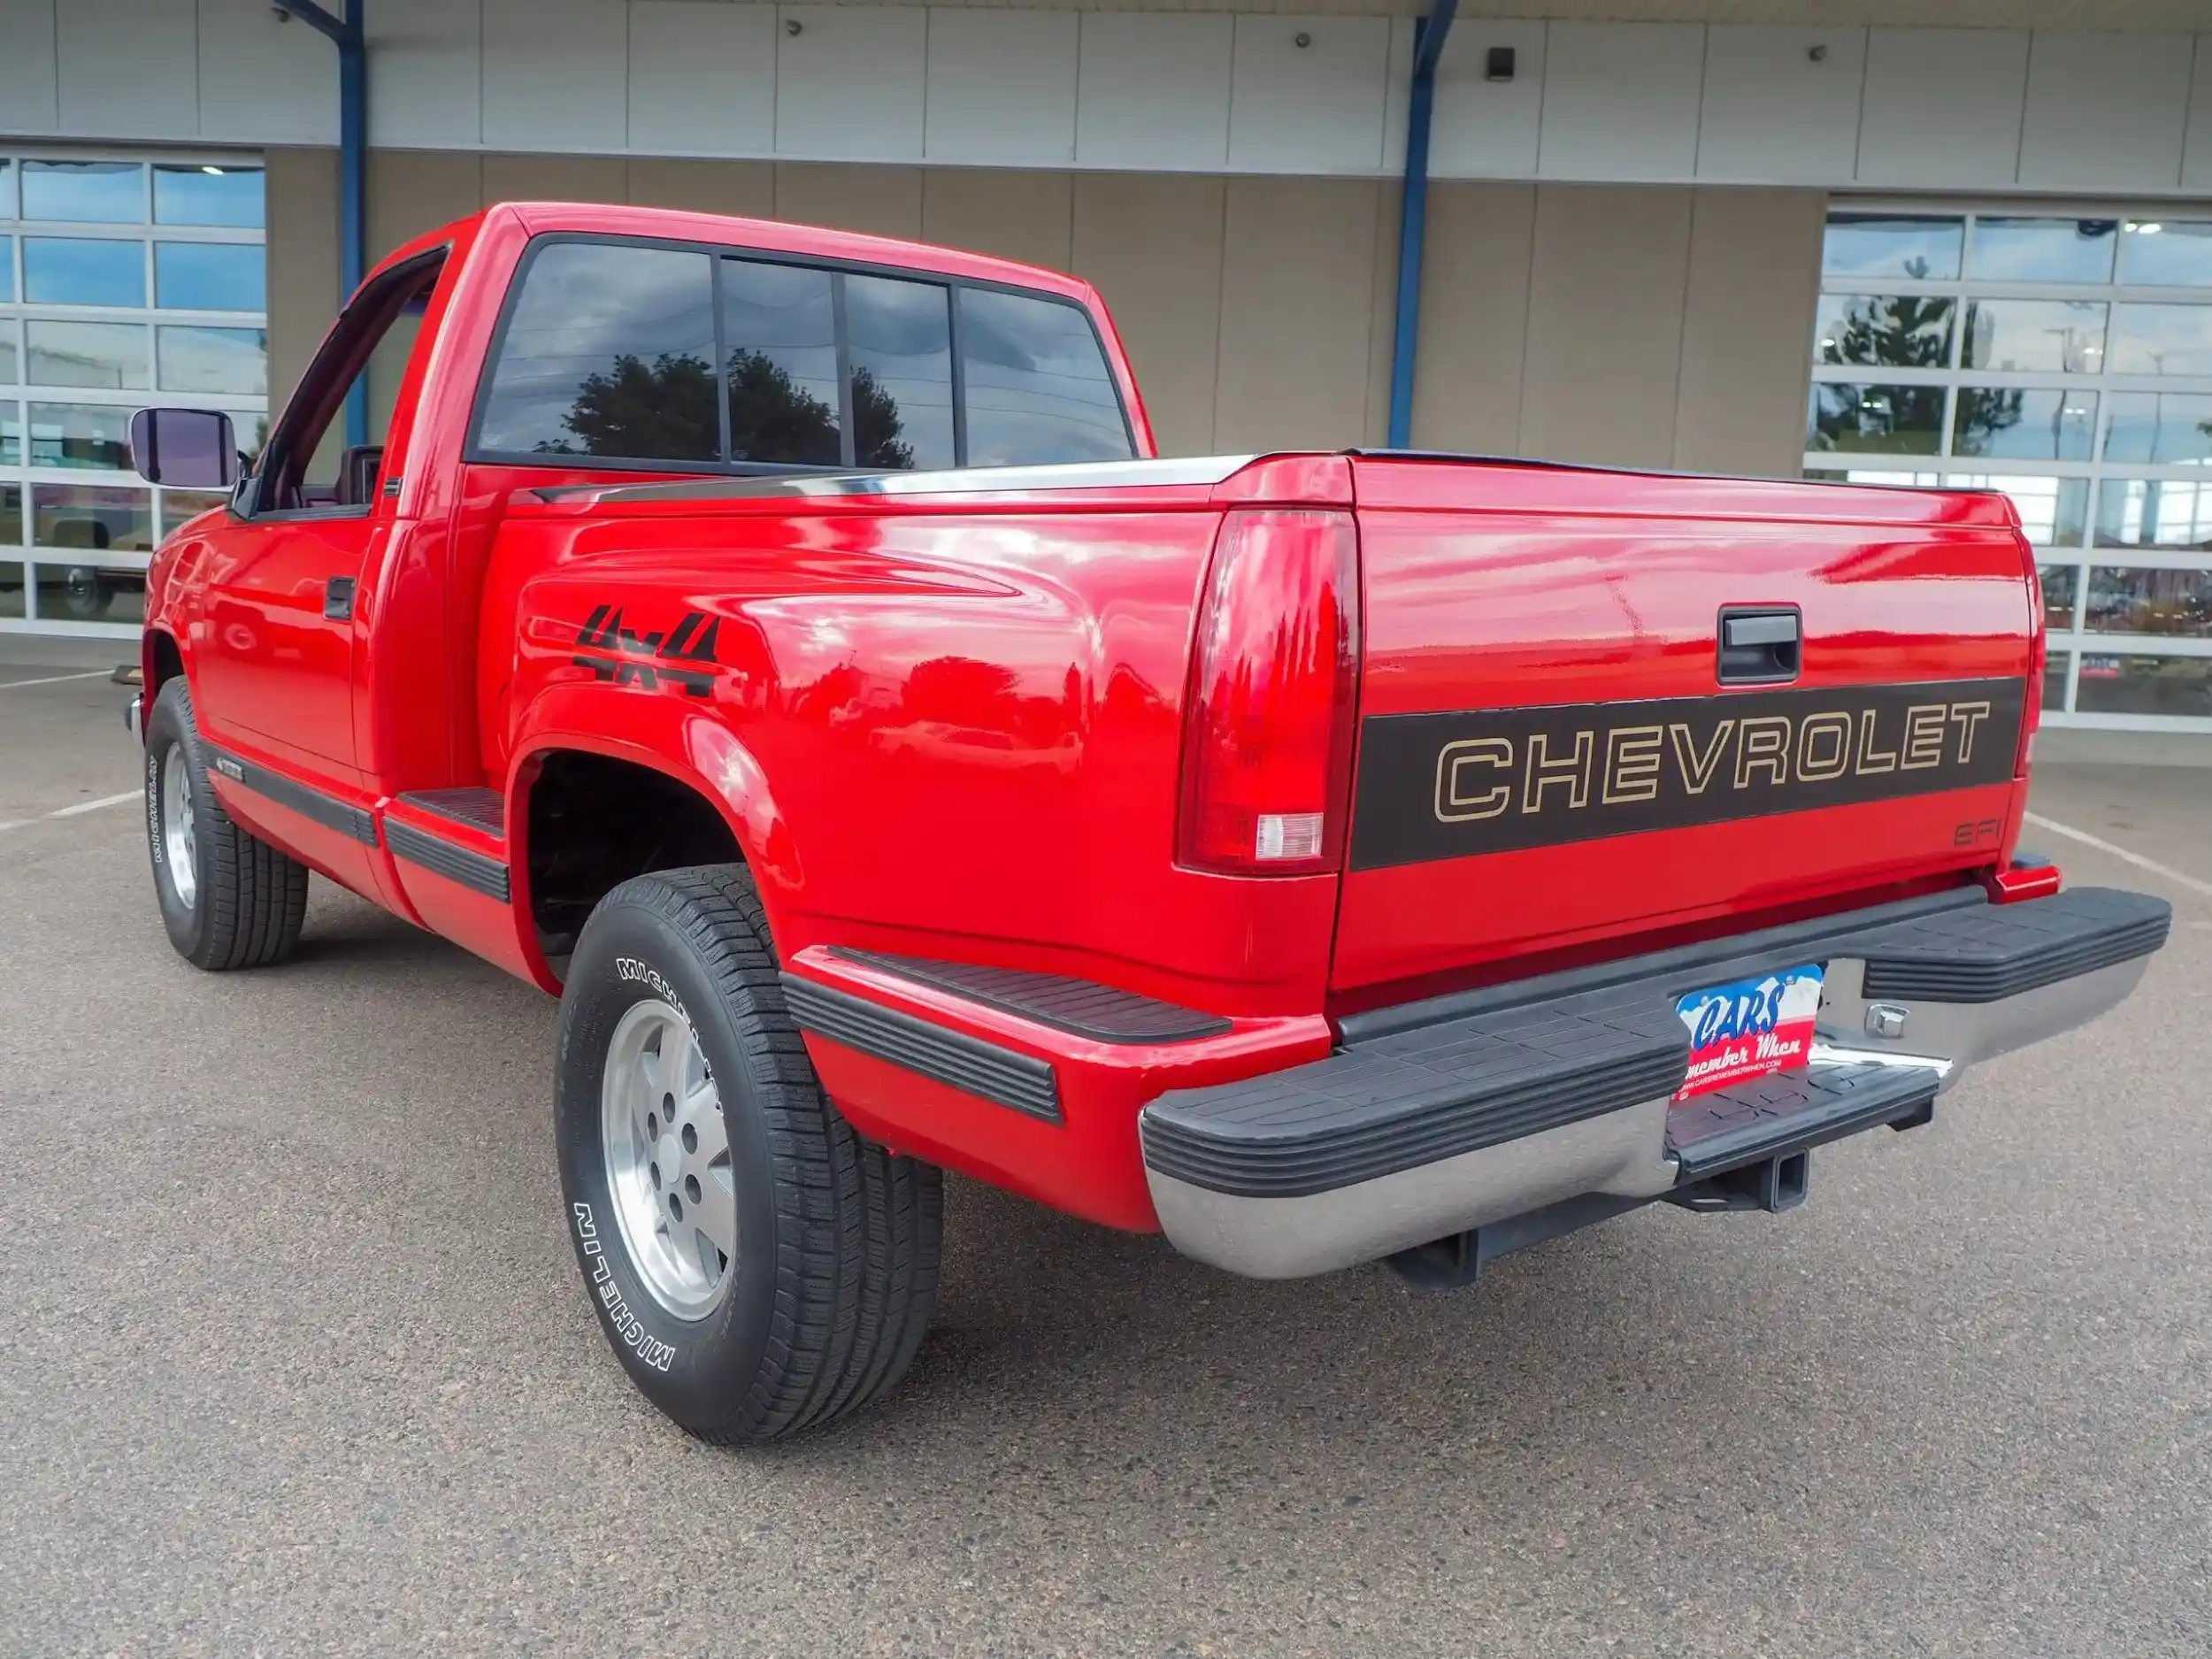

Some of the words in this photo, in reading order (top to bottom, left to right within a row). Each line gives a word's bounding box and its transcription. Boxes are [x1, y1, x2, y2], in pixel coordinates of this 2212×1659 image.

[1434, 701, 1991, 823] CHEVROLET
[1954, 818, 2001, 847] EFI
[1693, 982, 1786, 1051] CARS
[1685, 1046, 1749, 1080] member
[1755, 1033, 1801, 1060] When
[574, 1202, 676, 1372] MICHELIN
